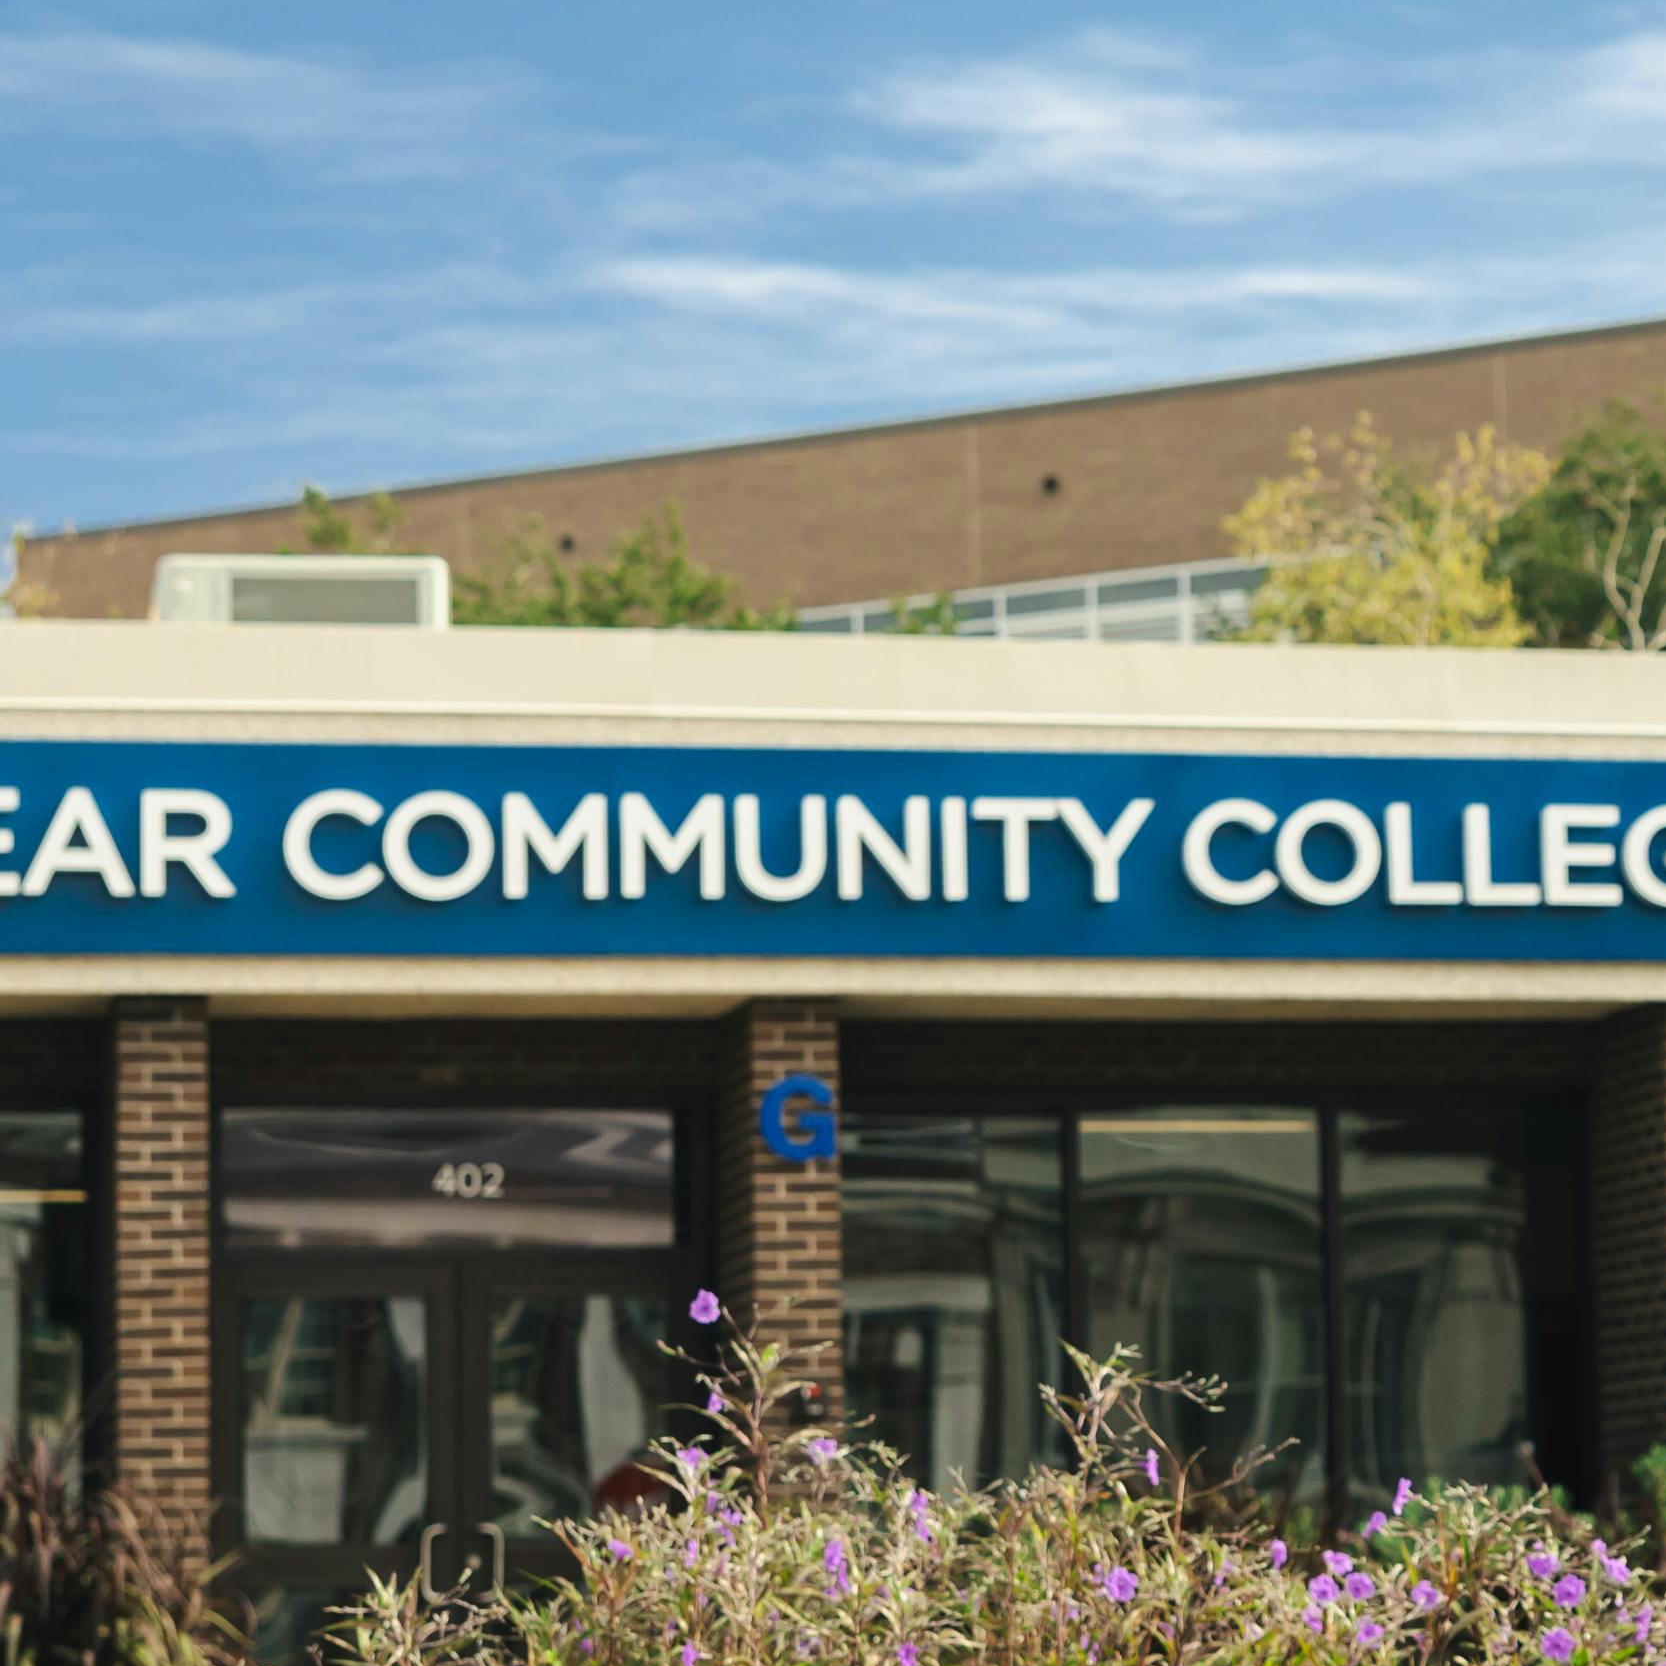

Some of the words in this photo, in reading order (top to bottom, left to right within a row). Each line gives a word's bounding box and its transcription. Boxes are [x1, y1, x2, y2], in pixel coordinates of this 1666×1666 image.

[0, 786, 236, 898] AR
[282, 788, 1156, 903] COMMUNITY
[760, 1073, 837, 1163] G
[432, 1162, 506, 1200] 402
